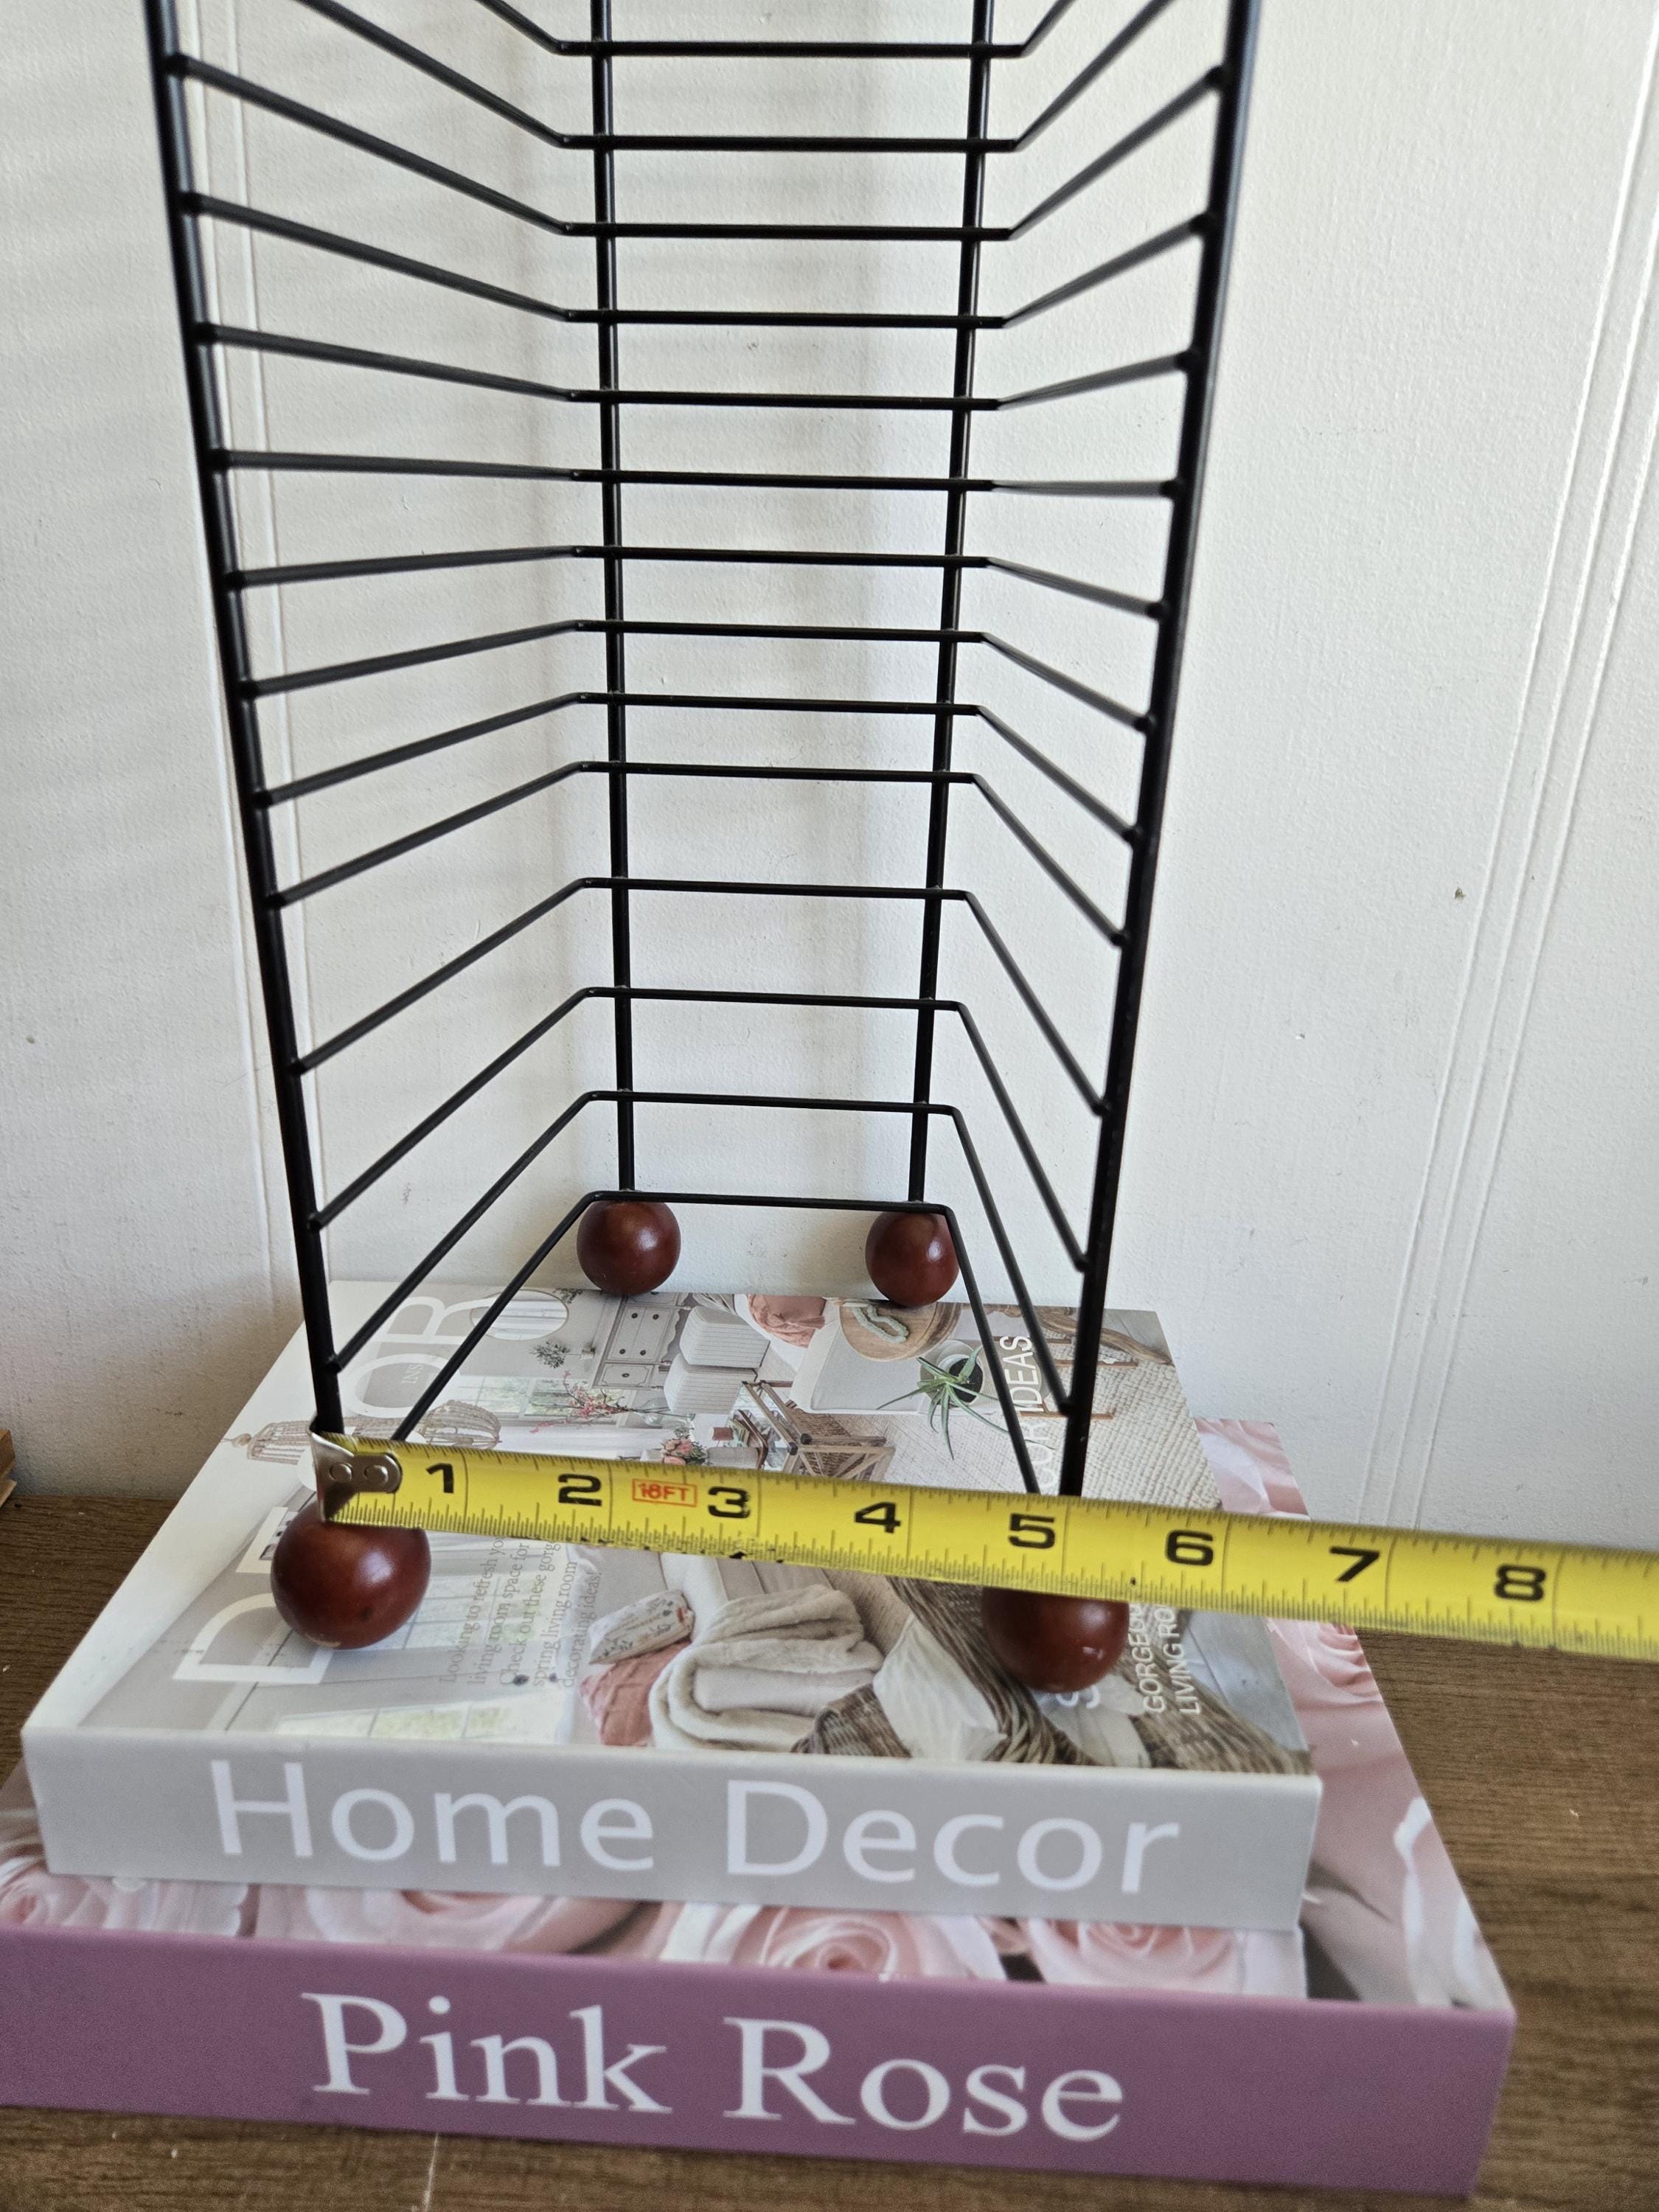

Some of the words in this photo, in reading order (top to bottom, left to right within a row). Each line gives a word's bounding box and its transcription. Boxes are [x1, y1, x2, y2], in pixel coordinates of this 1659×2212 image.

[999, 1335, 1044, 1412] IDEAS
[426, 1463, 453, 1493] 1
[558, 1473, 602, 1506] 2
[708, 1486, 751, 1518] 3
[854, 1501, 901, 1534] 4
[1008, 1513, 1056, 1549] 5
[1164, 1529, 1214, 1566] 6
[1329, 1546, 1380, 1582] 7
[1493, 1564, 1546, 1601] 8
[489, 1537, 506, 1556] yo
[509, 1543, 529, 1561] for
[473, 1558, 498, 1601] refresh
[502, 1563, 524, 1599] space
[522, 1573, 547, 1607] these
[560, 1560, 578, 1598] room
[467, 1604, 481, 1621] to
[488, 1603, 511, 1641] room
[519, 1610, 536, 1635] out
[540, 1599, 572, 1639] living
[557, 1611, 597, 1688] decorating
[578, 1571, 602, 1609] ideas!
[439, 1621, 481, 1683] Looking
[467, 1644, 502, 1685] living
[499, 1637, 527, 1685] Check
[532, 1640, 561, 1687] spring
[1128, 1604, 1166, 1714] GORGEOU
[1163, 1643, 1202, 1716] LIVING
[210, 1759, 654, 1871] Home
[726, 1778, 1180, 1894] Decor
[300, 1991, 672, 2114] Pink
[723, 2017, 1123, 2141] Rose
